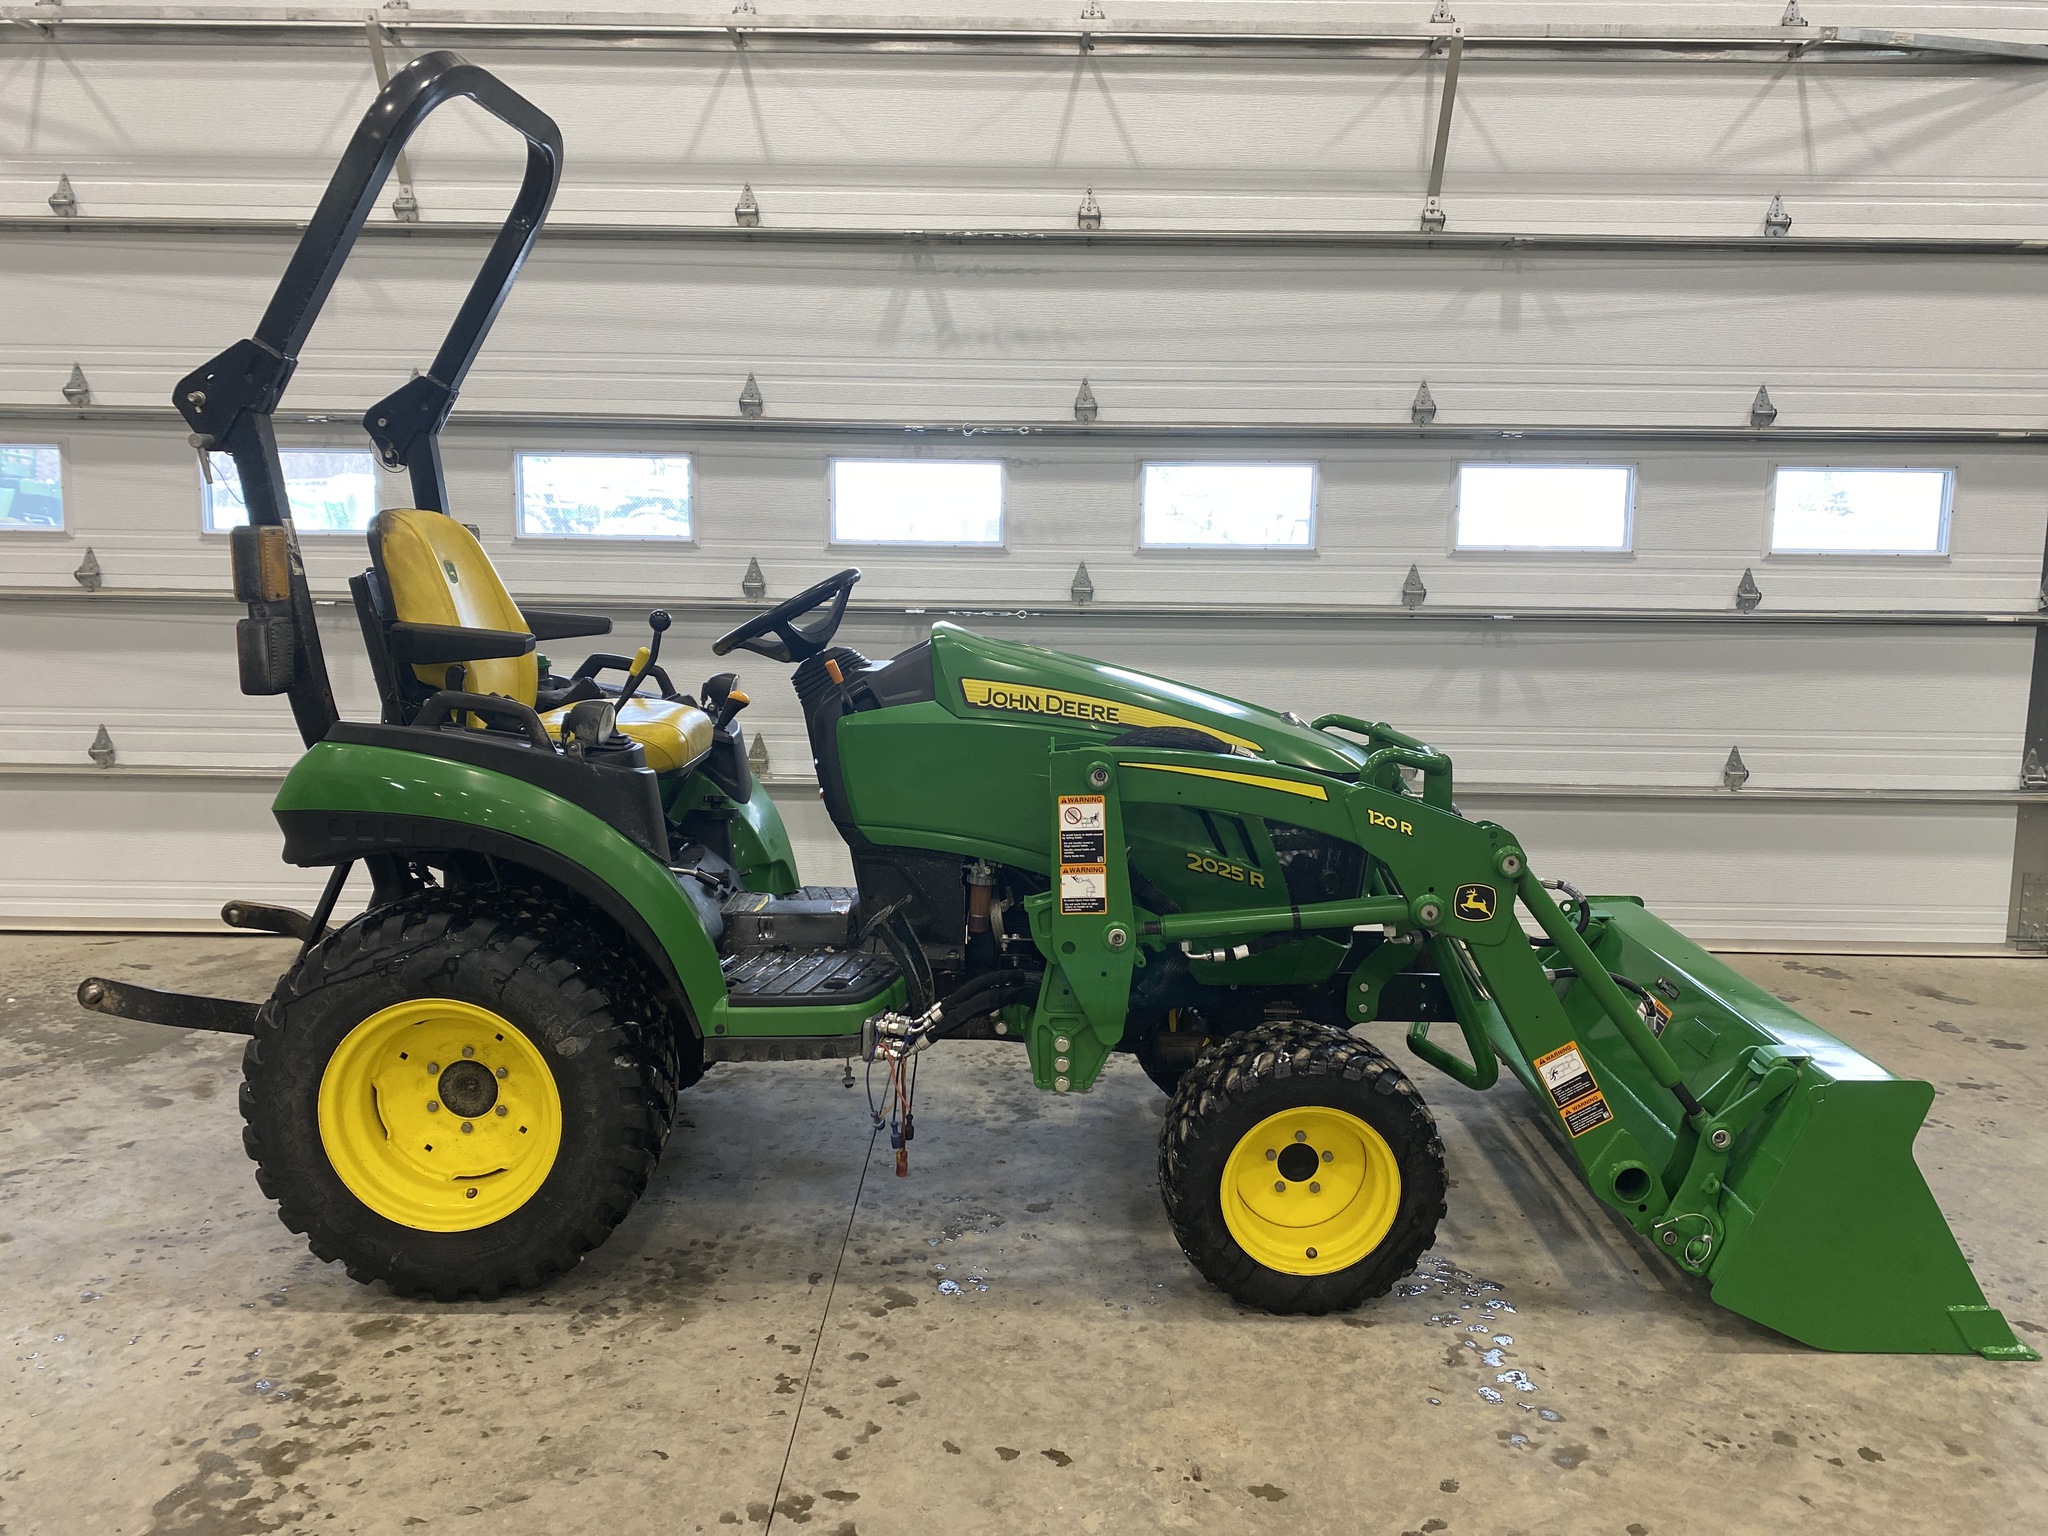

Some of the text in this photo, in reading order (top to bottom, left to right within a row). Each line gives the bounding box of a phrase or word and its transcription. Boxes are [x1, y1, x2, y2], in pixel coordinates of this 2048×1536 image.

[979, 687, 1119, 722] JOHN DEERE
[1367, 809, 1413, 836] 120 R
[1186, 852, 1265, 889] 2025 R
[1545, 1045, 1572, 1061] WARNING
[1571, 1095, 1599, 1112] WARNING
